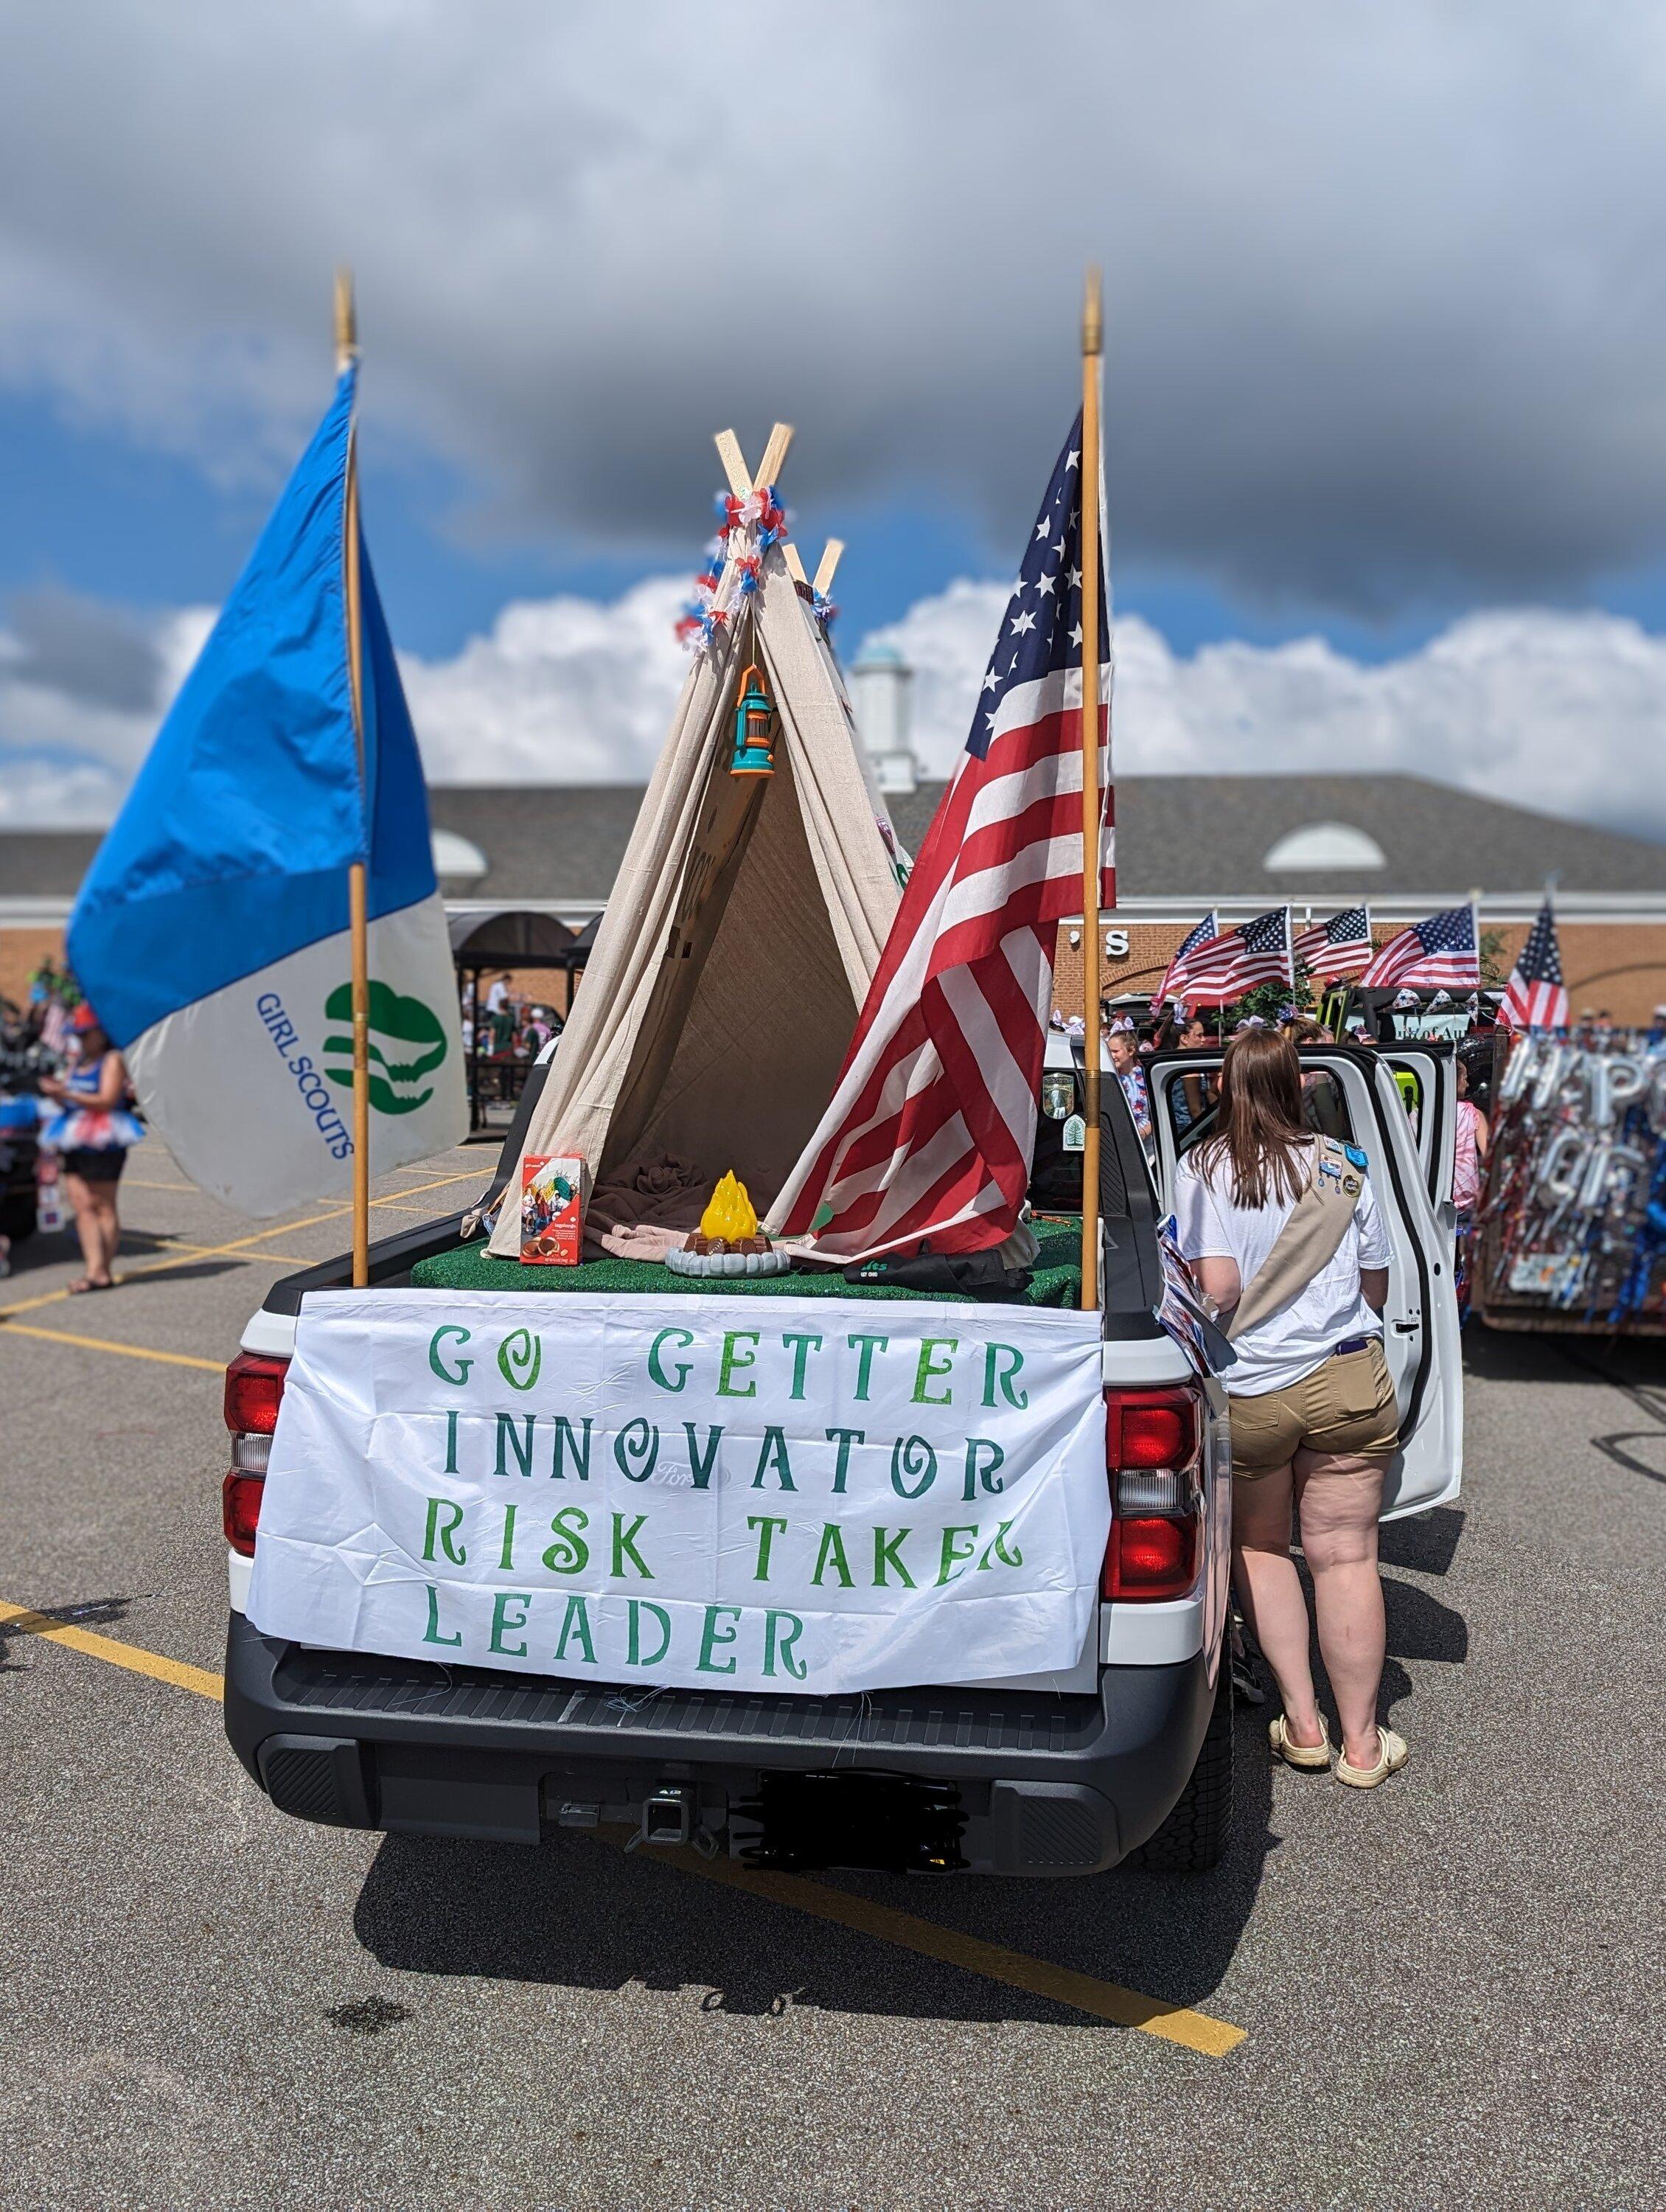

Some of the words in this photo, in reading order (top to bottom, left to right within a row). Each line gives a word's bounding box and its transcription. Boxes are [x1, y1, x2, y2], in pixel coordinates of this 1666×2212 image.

[257, 993, 299, 1058] GIRL
[288, 1056, 355, 1160] SCOUTS
[430, 1326, 540, 1392] GO
[648, 1328, 1028, 1409] GETTER
[446, 1411, 1004, 1500] INNOVATOR
[423, 1498, 654, 1579] RISK
[422, 1585, 806, 1680] LEADER
